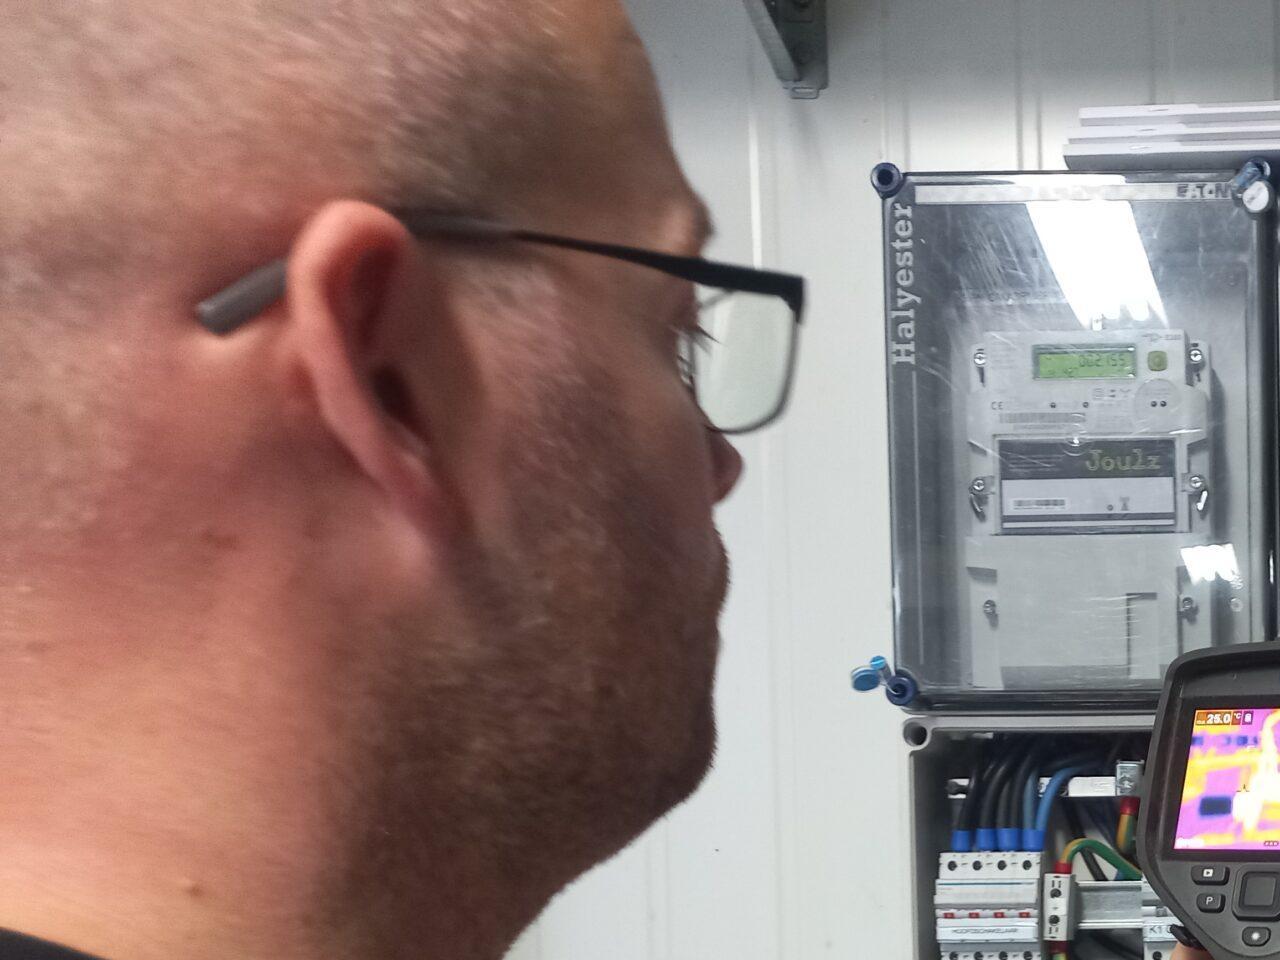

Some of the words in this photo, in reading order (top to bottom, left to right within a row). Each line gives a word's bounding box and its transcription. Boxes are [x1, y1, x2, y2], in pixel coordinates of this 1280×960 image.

[891, 202, 922, 366] Halyester
[1085, 448, 1162, 472] Joulz
[1205, 896, 1213, 905] P
